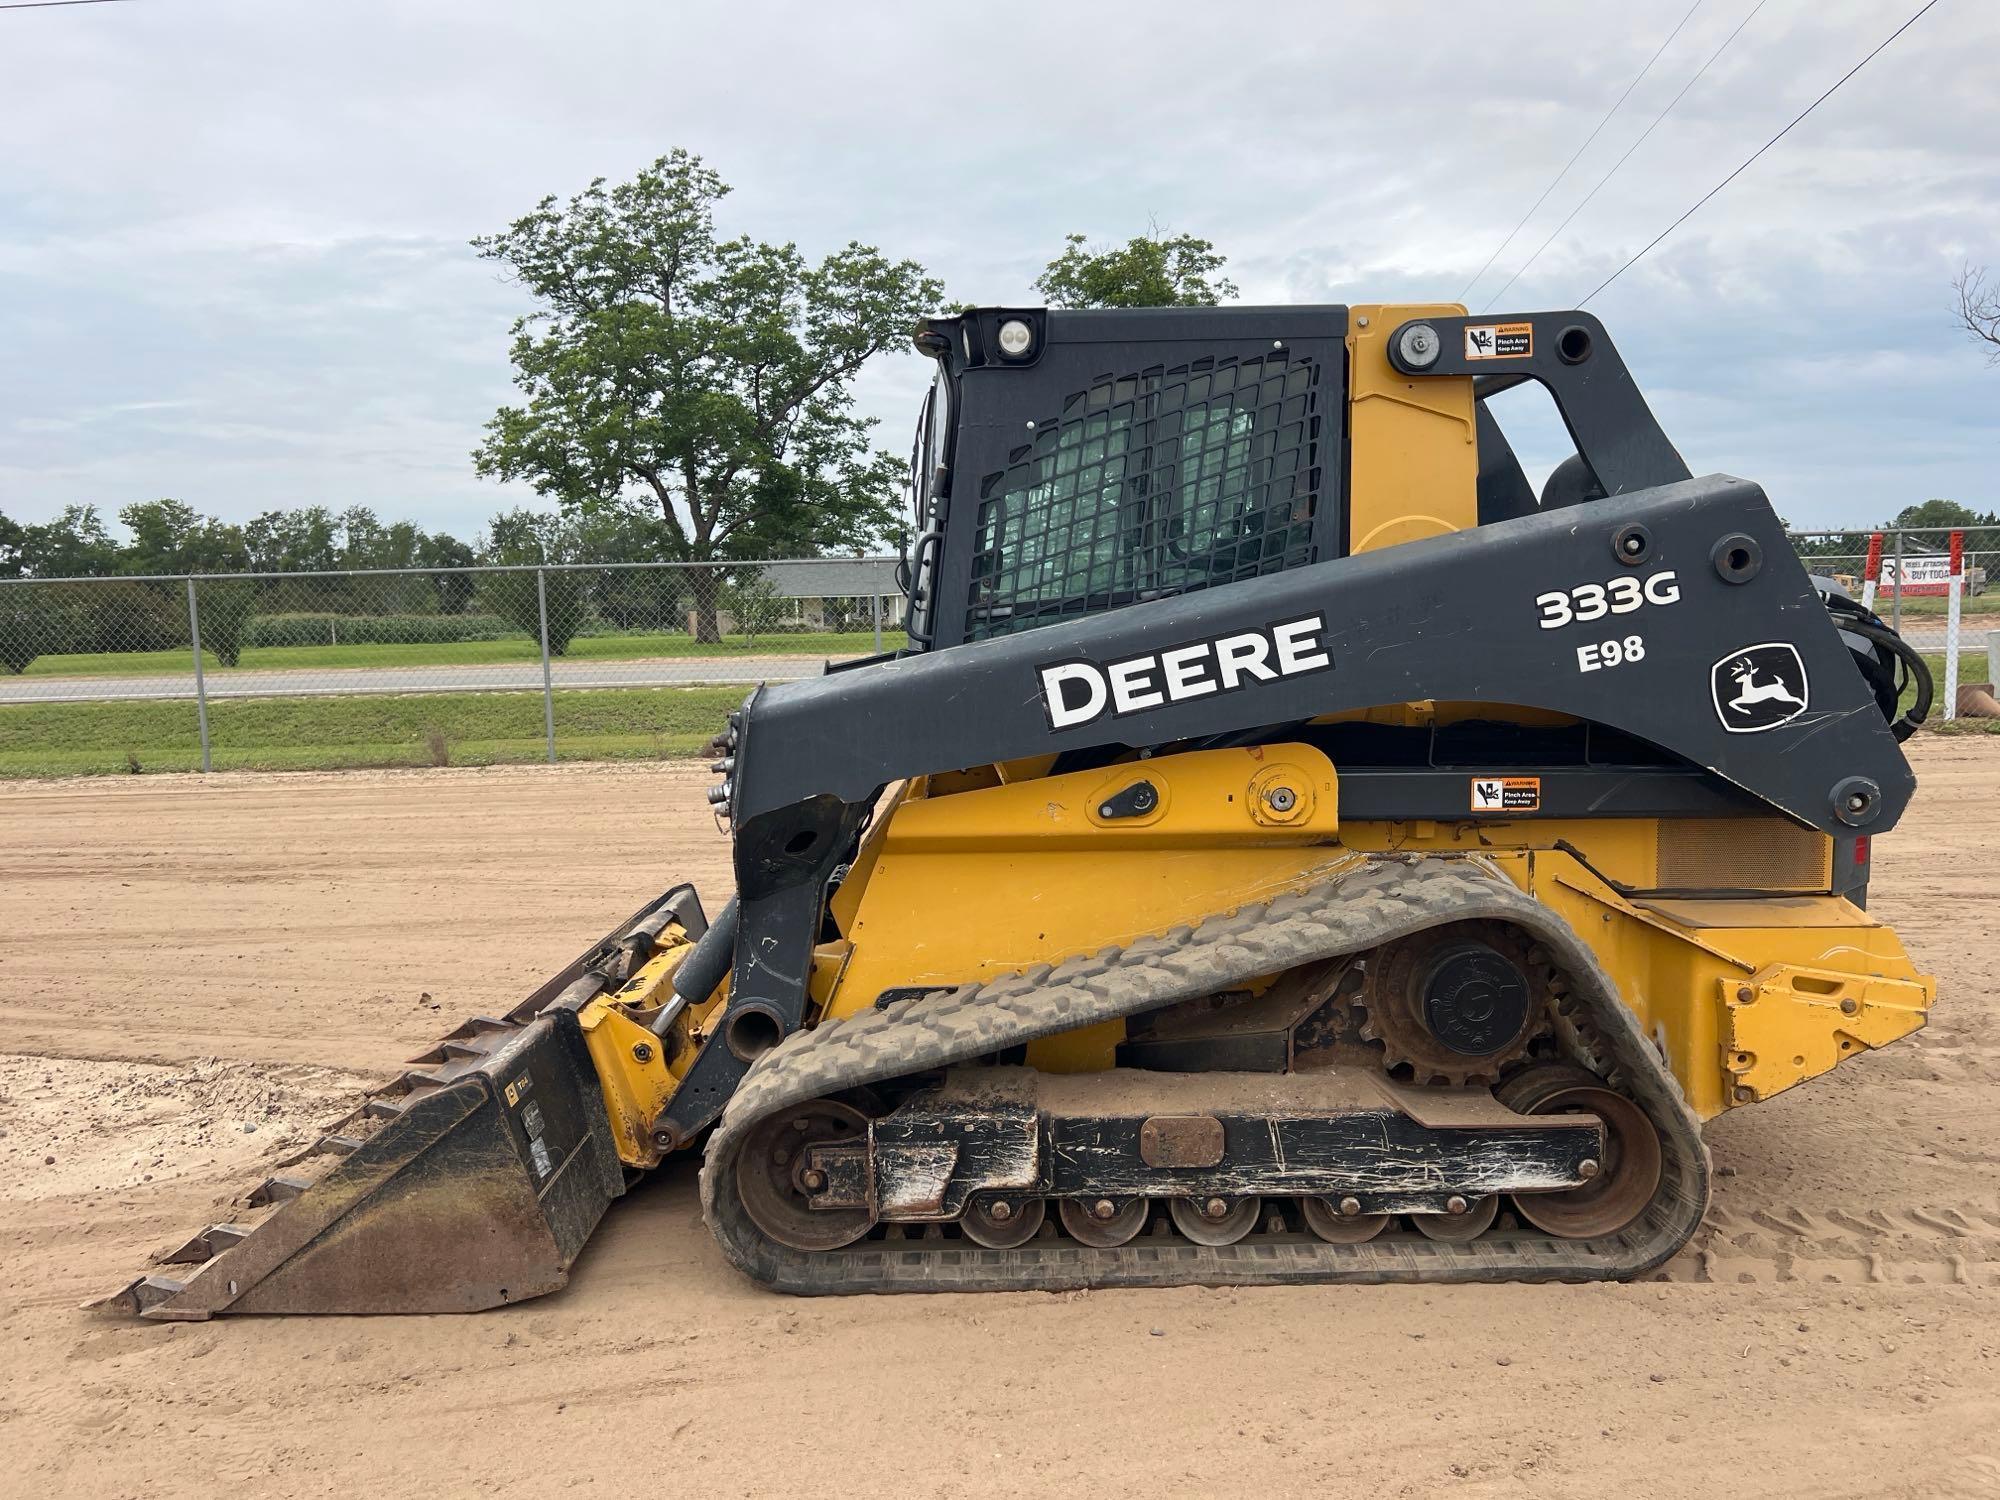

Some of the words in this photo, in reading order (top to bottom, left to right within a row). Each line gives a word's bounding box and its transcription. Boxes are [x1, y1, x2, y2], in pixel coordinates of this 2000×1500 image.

[1912, 571, 1928, 580] BUY
[1929, 570, 1950, 579] TODA
[1536, 571, 1681, 629] 333G
[1041, 616, 1330, 728] DEERE
[1577, 635, 1646, 673] E98
